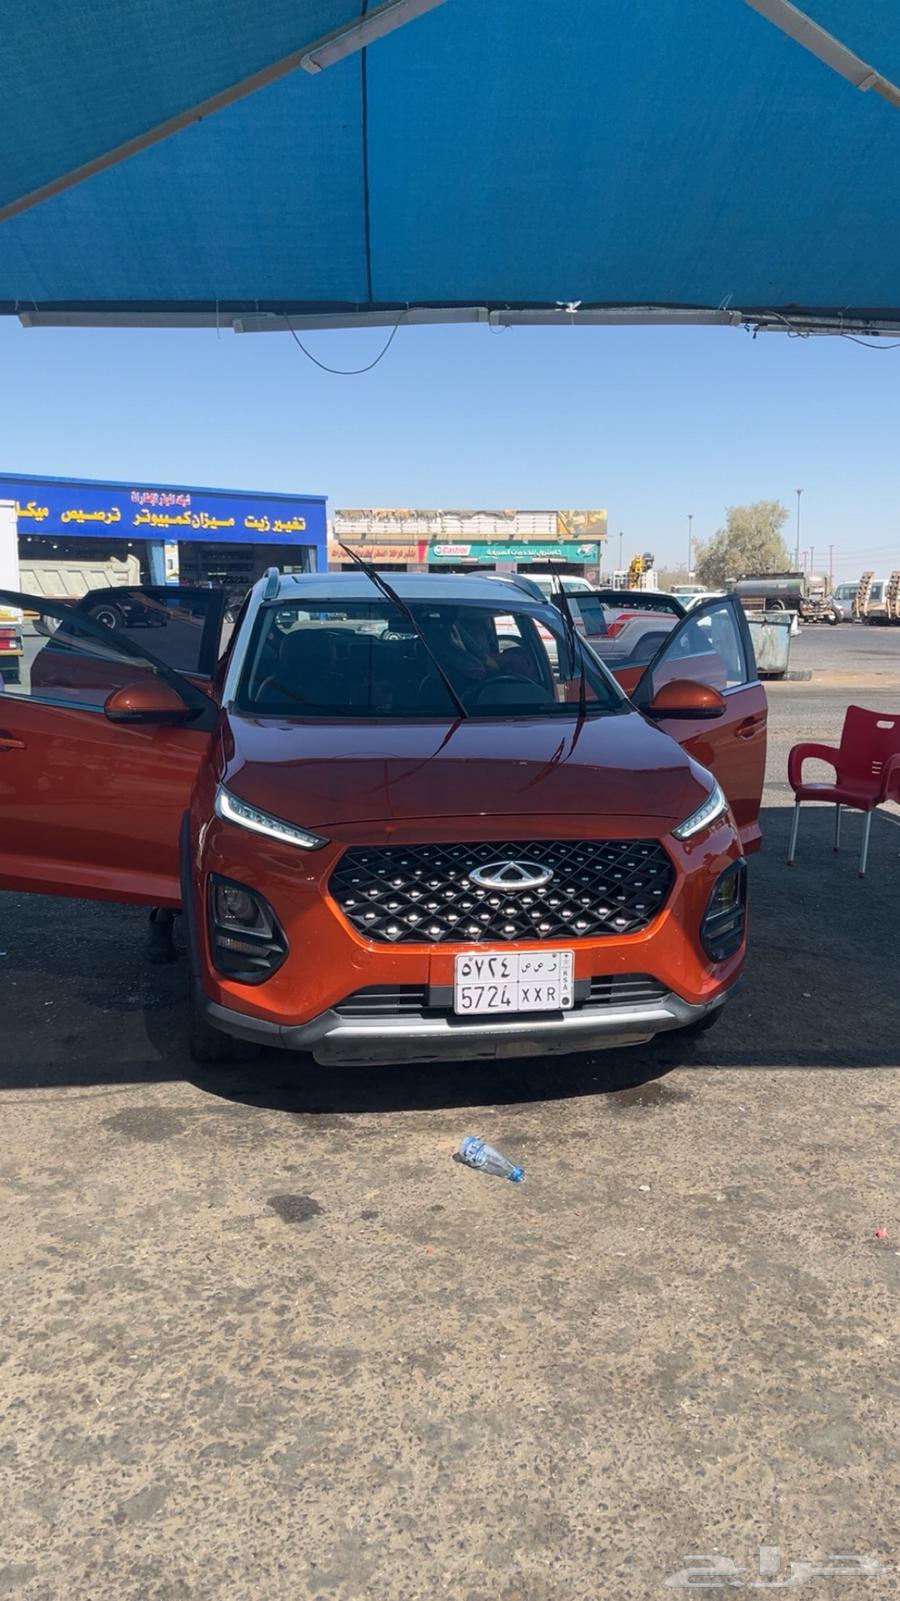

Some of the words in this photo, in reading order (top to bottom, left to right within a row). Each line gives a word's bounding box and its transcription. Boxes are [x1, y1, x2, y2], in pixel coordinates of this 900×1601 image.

[60, 507, 121, 525] ترصيص
[132, 508, 191, 528] كمبيوتر
[192, 512, 235, 529] ميزان
[244, 515, 271, 532] زيت
[272, 516, 306, 533] تغيير
[442, 546, 468, 555] Castrol
[461, 957, 511, 979] ٥٧٢٤
[461, 985, 512, 1009] 5724
